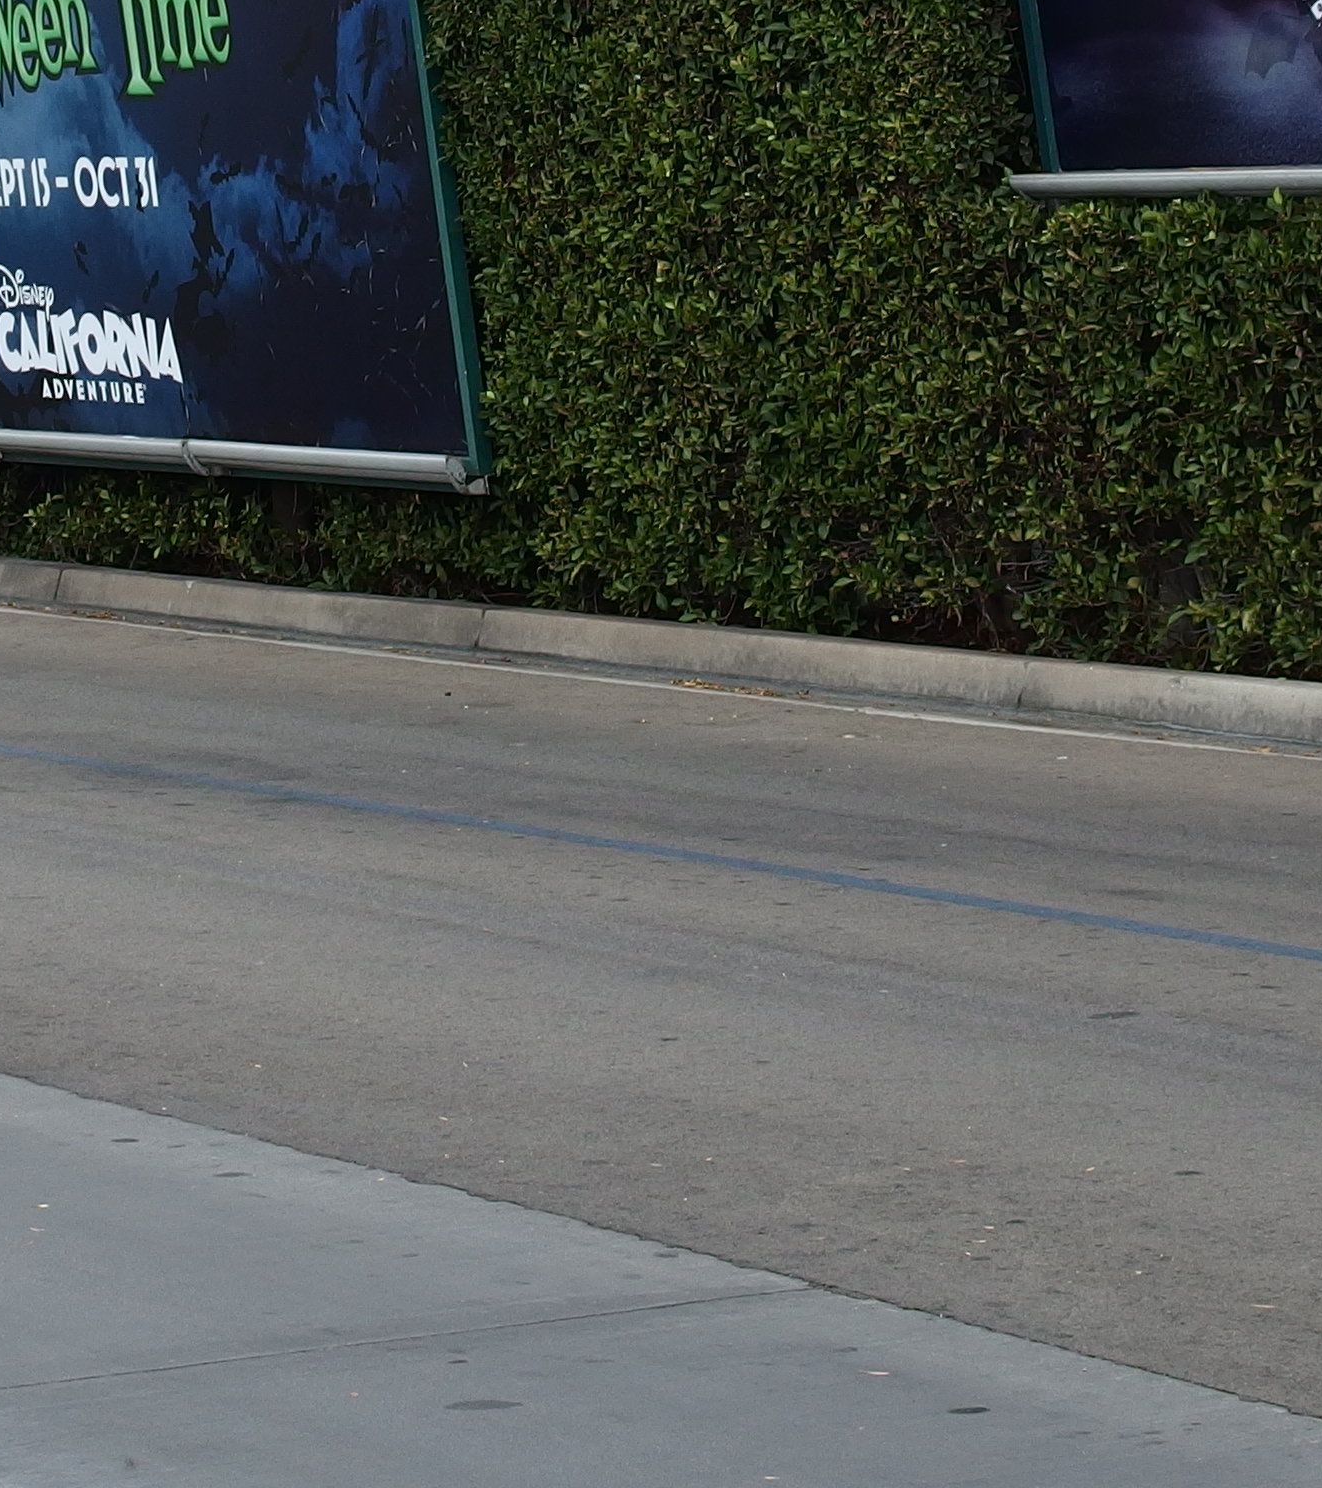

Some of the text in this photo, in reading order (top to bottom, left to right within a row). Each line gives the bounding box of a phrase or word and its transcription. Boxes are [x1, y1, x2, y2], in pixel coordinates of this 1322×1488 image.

[31, 157, 51, 207] 15
[74, 156, 129, 207] OCT
[134, 156, 159, 207] 31
[42, 377, 146, 404] ADVENTURE
